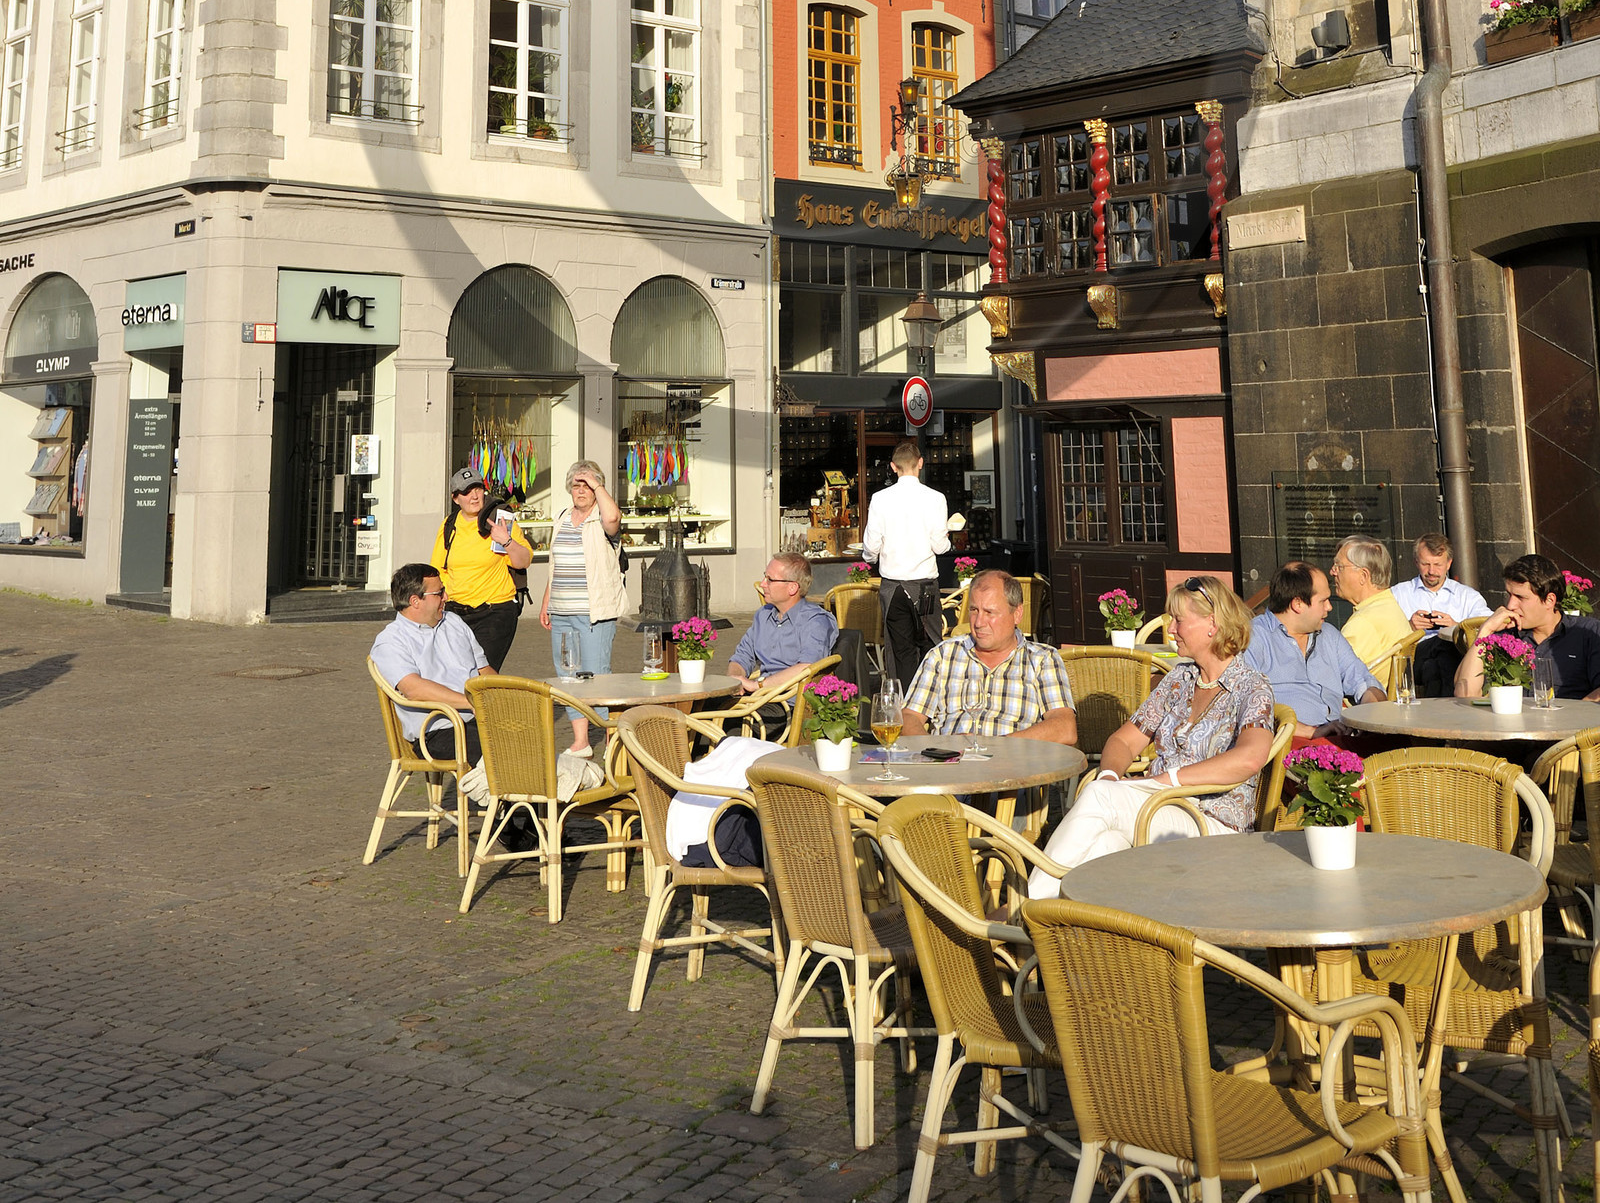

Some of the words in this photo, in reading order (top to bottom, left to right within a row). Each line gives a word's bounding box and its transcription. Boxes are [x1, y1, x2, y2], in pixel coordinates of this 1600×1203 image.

[796, 194, 855, 229] Haus
[121, 302, 173, 326] eterna
[36, 356, 70, 372] OLYMP
